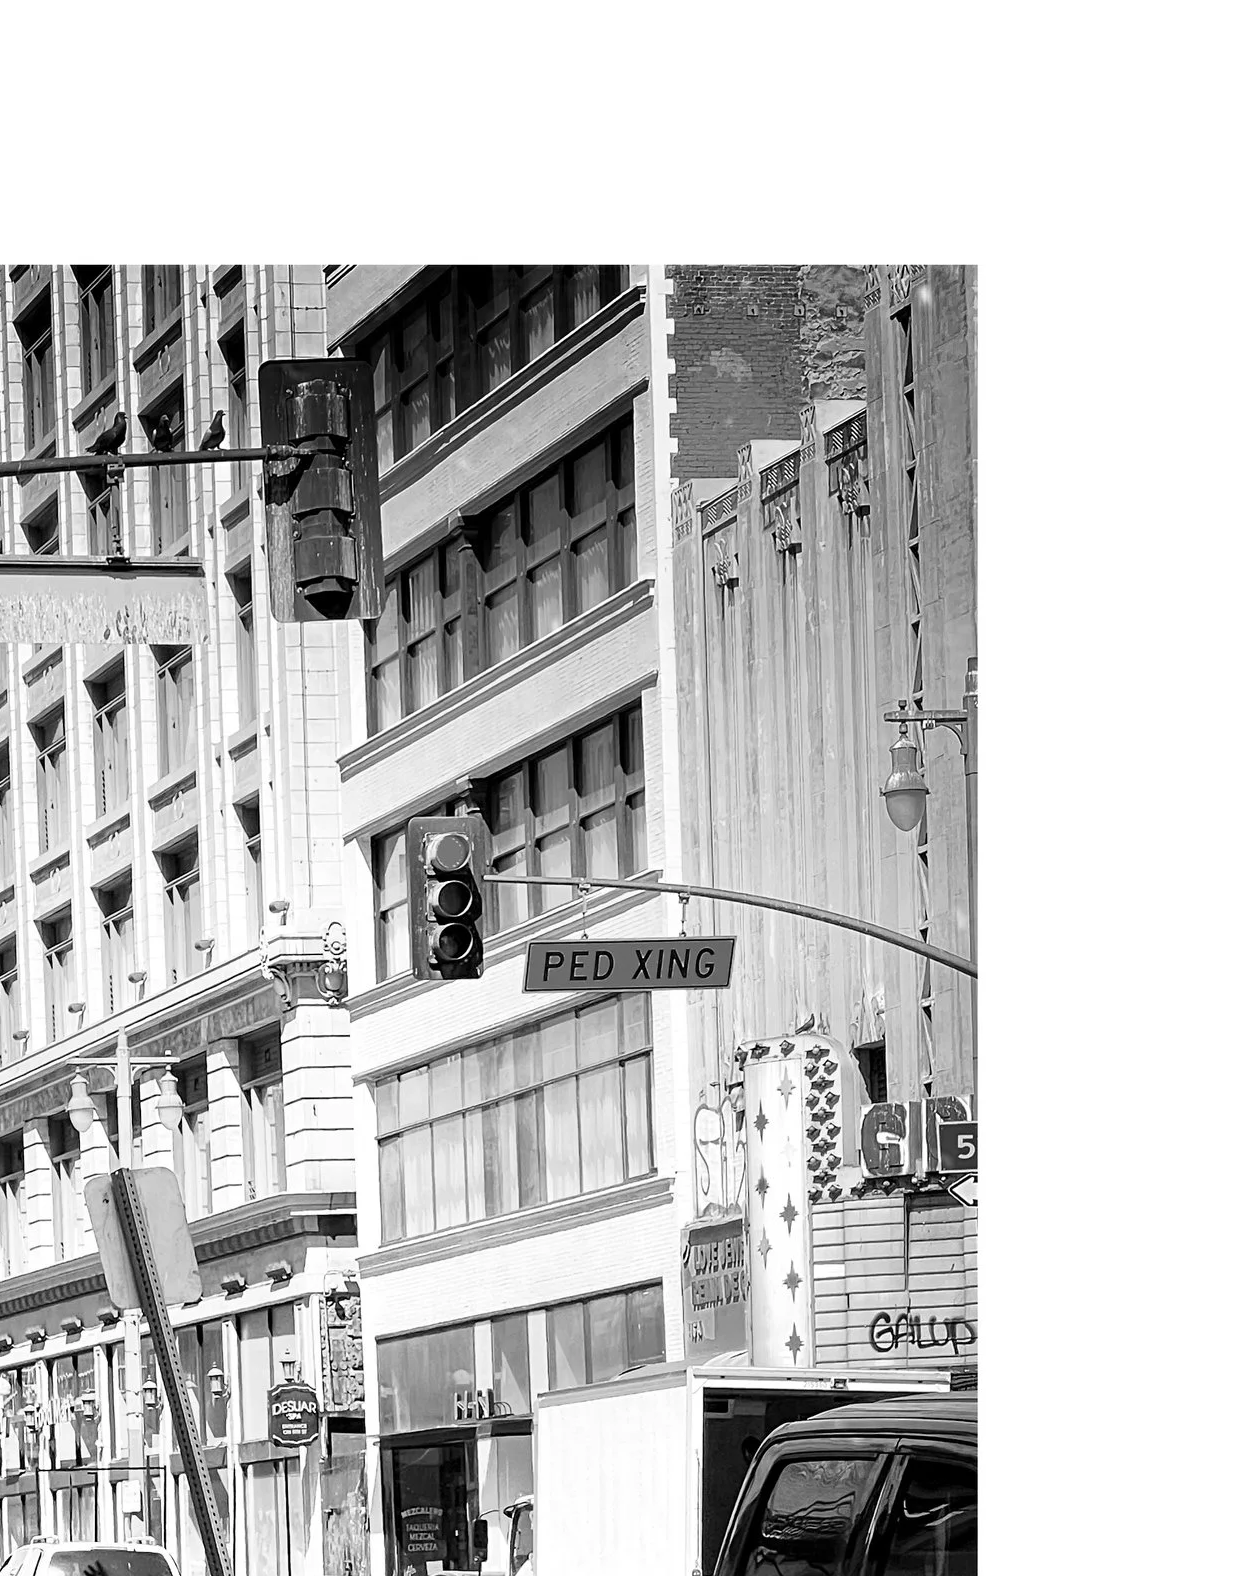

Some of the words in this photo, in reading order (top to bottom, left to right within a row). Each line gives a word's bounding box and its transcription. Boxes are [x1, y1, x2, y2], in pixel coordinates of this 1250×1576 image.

[542, 950, 615, 982] PED
[631, 947, 716, 980] XING
[271, 1400, 317, 1416] DESUAR
[405, 1522, 440, 1532] TAQUERIA
[409, 1532, 436, 1541] MEZCAL
[407, 1542, 439, 1552] CERVEZA
